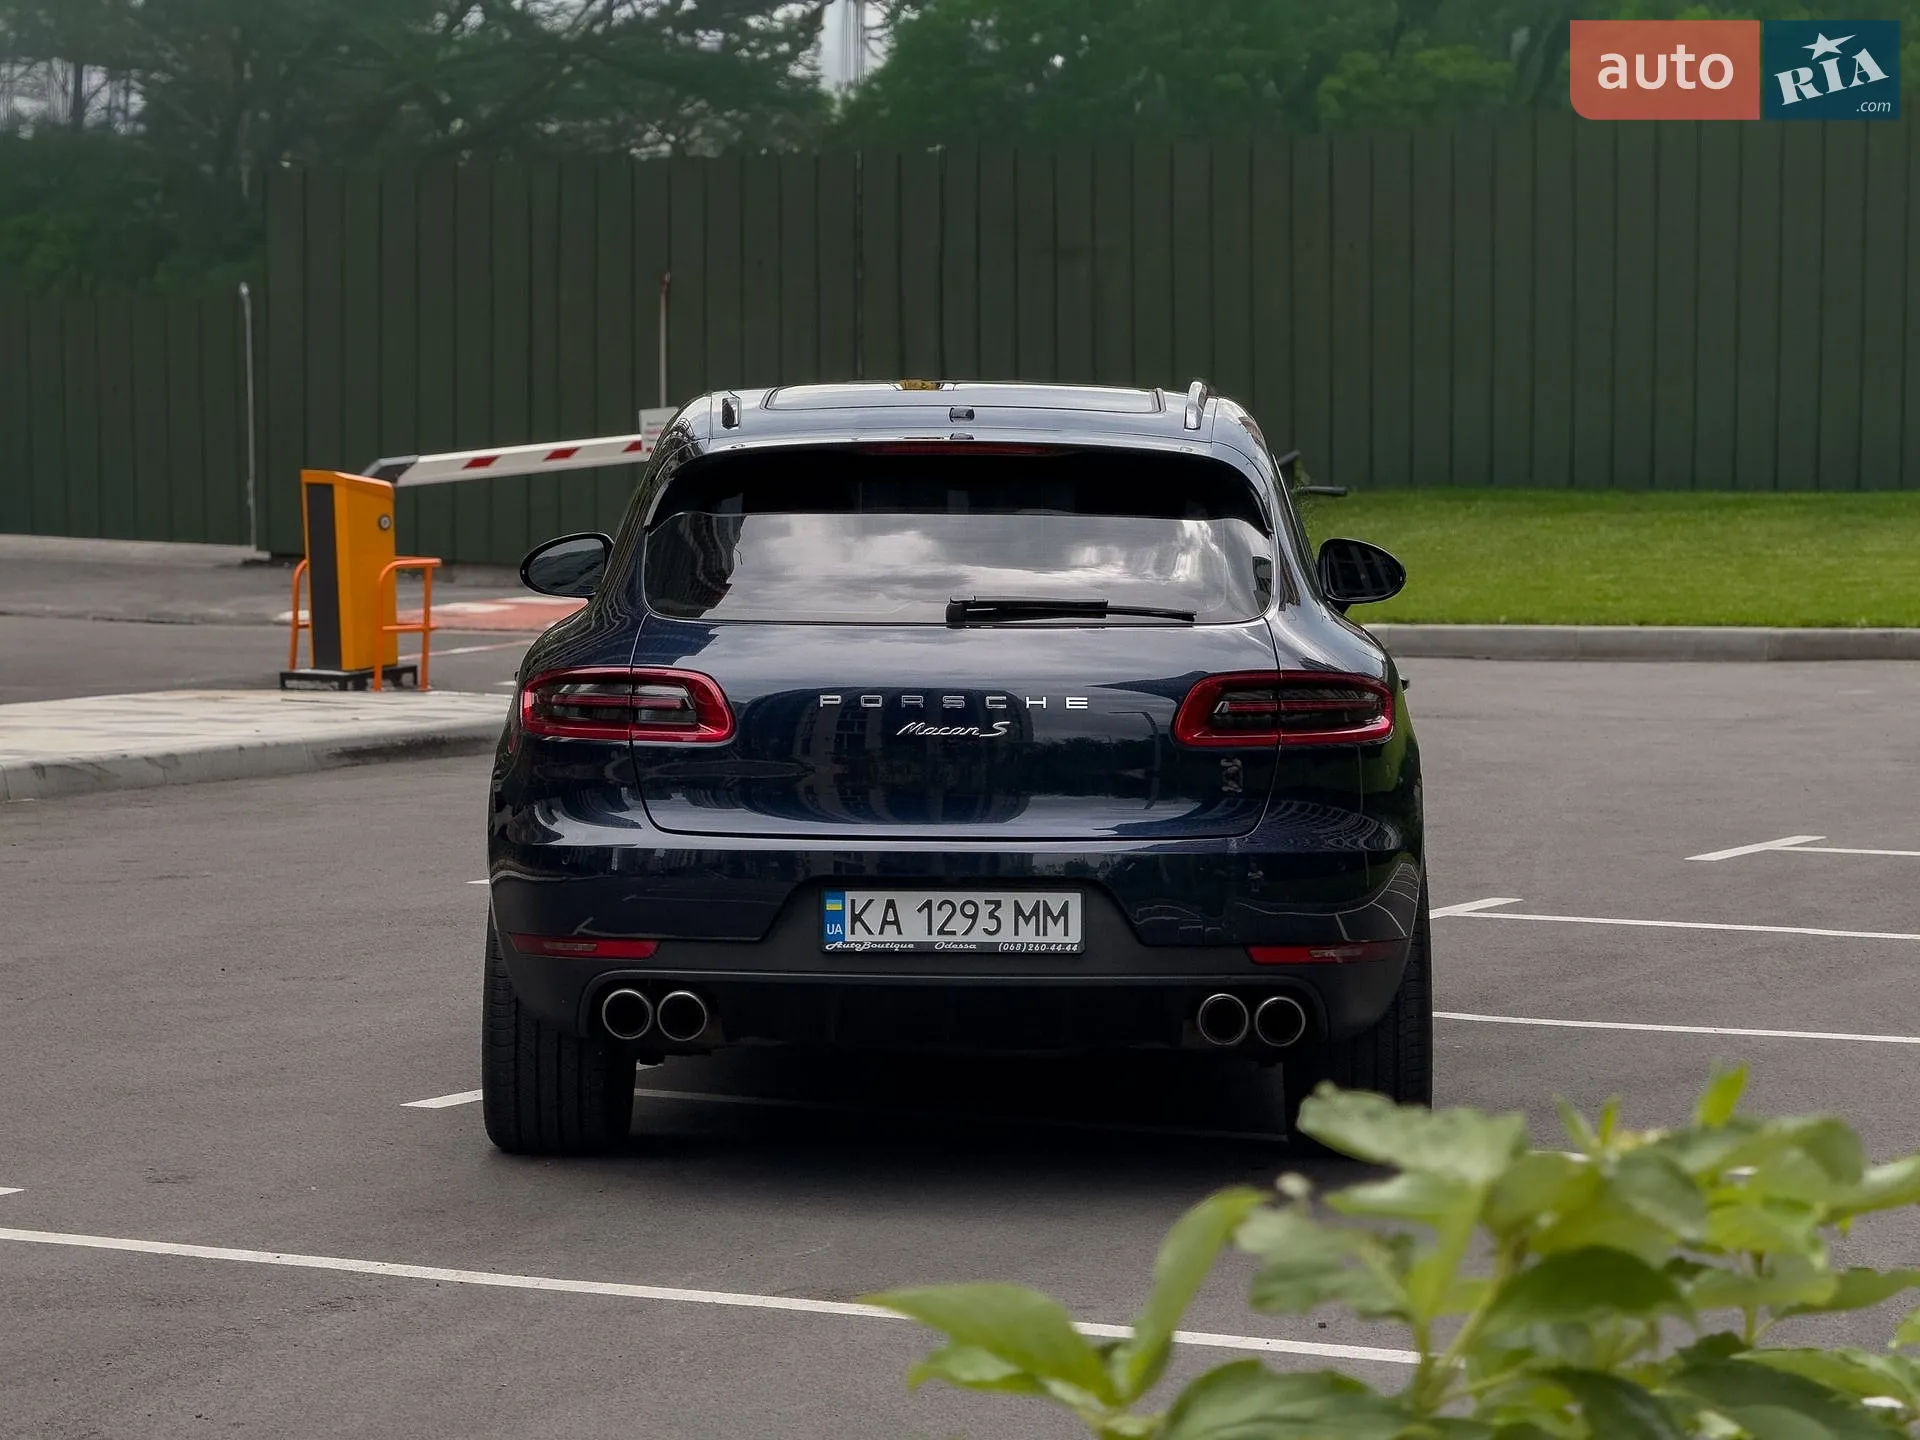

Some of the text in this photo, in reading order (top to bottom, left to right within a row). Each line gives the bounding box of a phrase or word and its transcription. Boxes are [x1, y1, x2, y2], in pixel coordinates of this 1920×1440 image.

[819, 694, 1089, 710] PORSCHE
[896, 721, 1011, 737] Macan S
[850, 898, 1069, 937] KA 1293 MM
[826, 923, 843, 935] UA
[825, 941, 915, 952] AutoBoutique
[934, 941, 977, 950] Odessa
